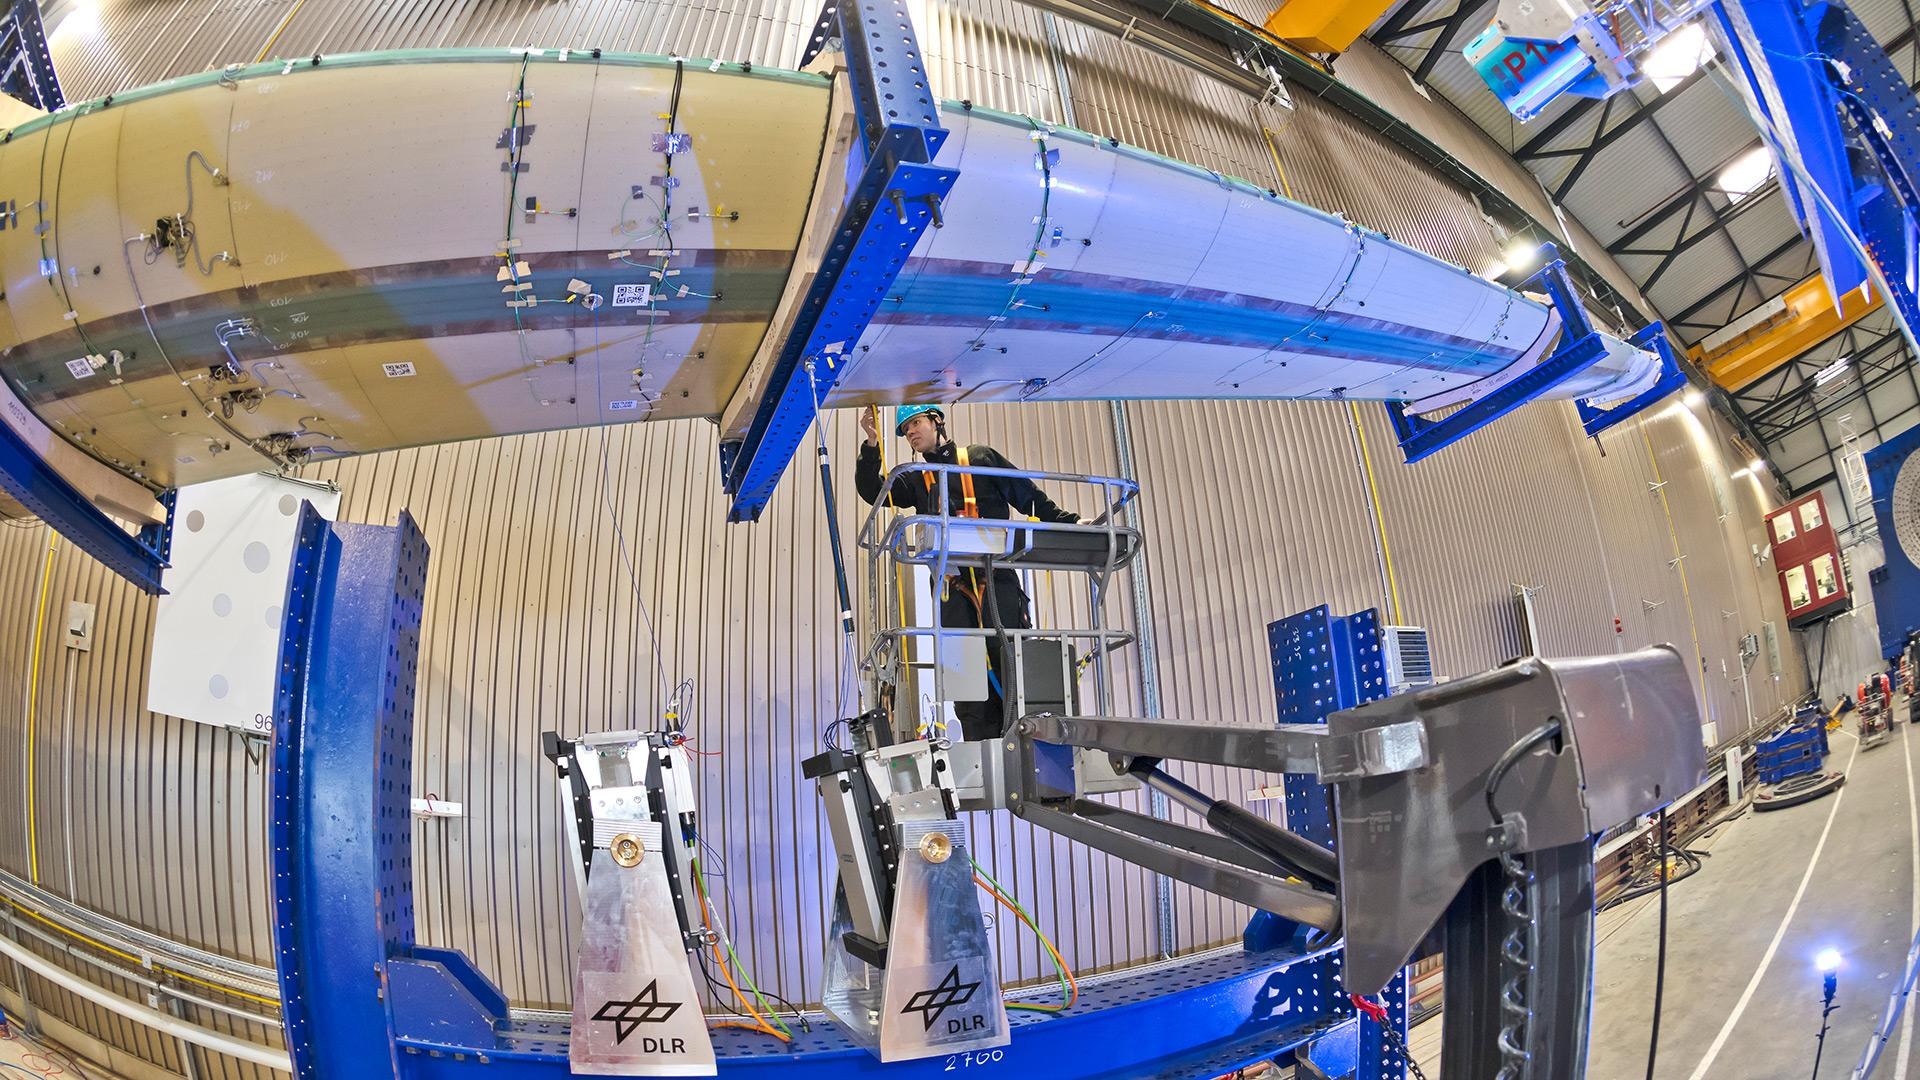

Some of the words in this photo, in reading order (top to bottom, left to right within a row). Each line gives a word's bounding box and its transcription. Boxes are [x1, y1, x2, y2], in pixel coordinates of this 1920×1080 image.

[254, 713, 273, 732] 96
[948, 1014, 985, 1034] DLR
[642, 1037, 686, 1054] DLR
[944, 1049, 1004, 1072] 2700
